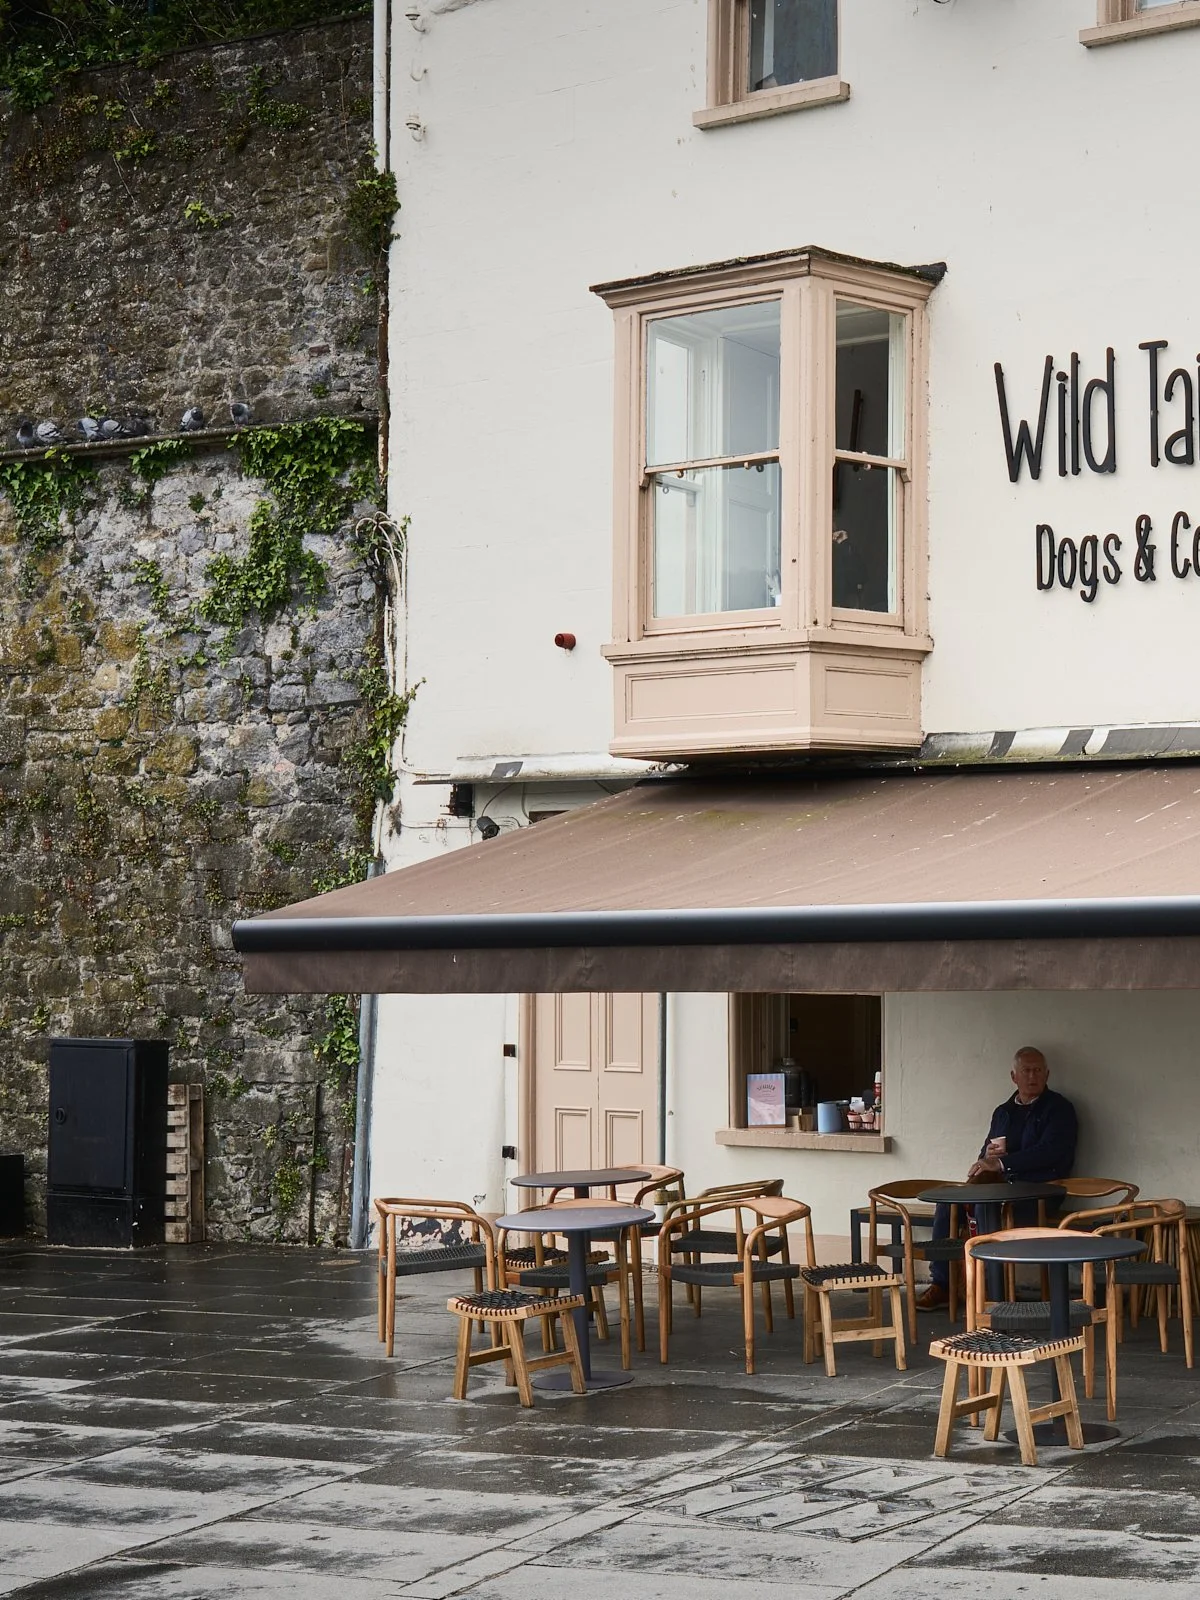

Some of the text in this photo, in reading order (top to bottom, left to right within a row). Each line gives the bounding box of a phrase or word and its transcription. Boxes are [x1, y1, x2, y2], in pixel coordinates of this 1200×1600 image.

[994, 346, 1116, 483] Wild
[1036, 524, 1122, 603] Dogs
[1134, 514, 1157, 582] &
